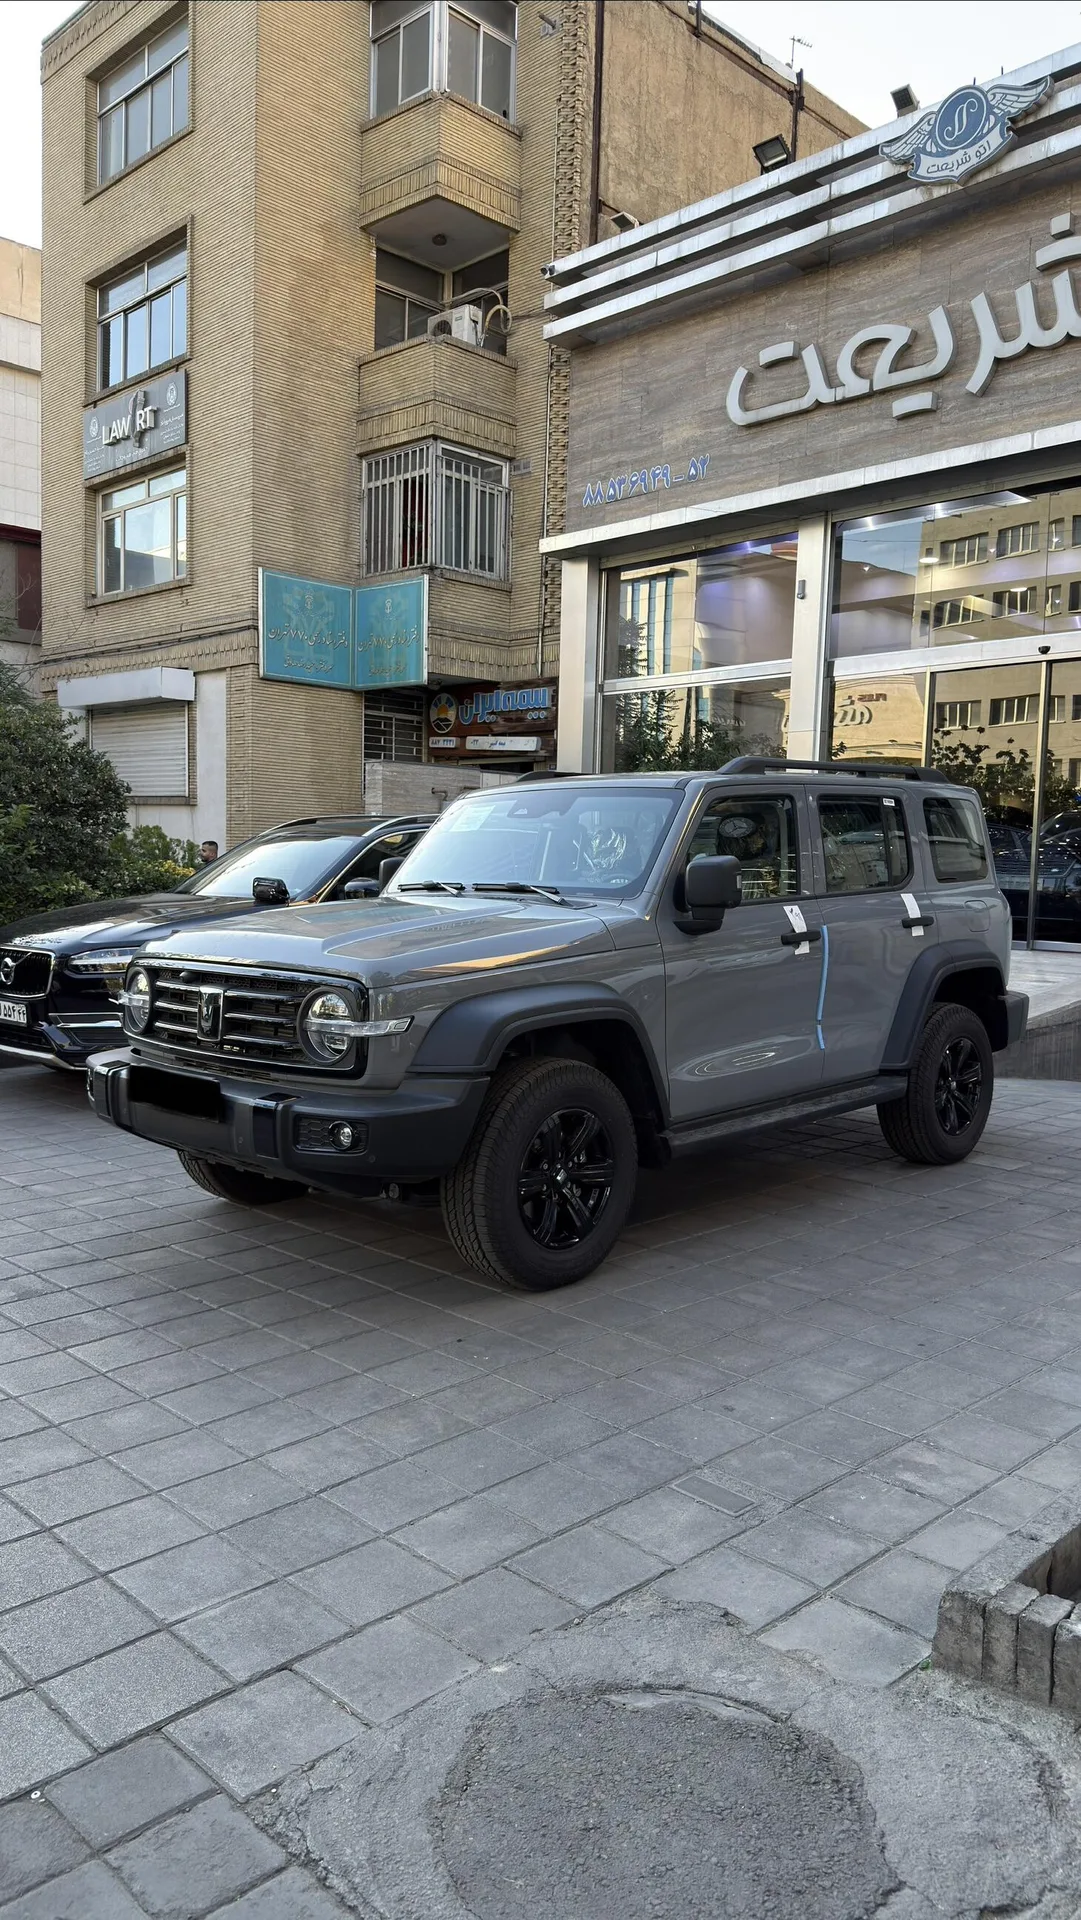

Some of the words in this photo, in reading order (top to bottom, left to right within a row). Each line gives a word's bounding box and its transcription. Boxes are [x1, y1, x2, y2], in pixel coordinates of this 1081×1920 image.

[926, 151, 972, 175] شریعت
[974, 140, 992, 161] اتو
[102, 414, 133, 446] LAW
[268, 623, 290, 641] تهران
[458, 689, 502, 725] ایران
[501, 687, 549, 720] بیمه
